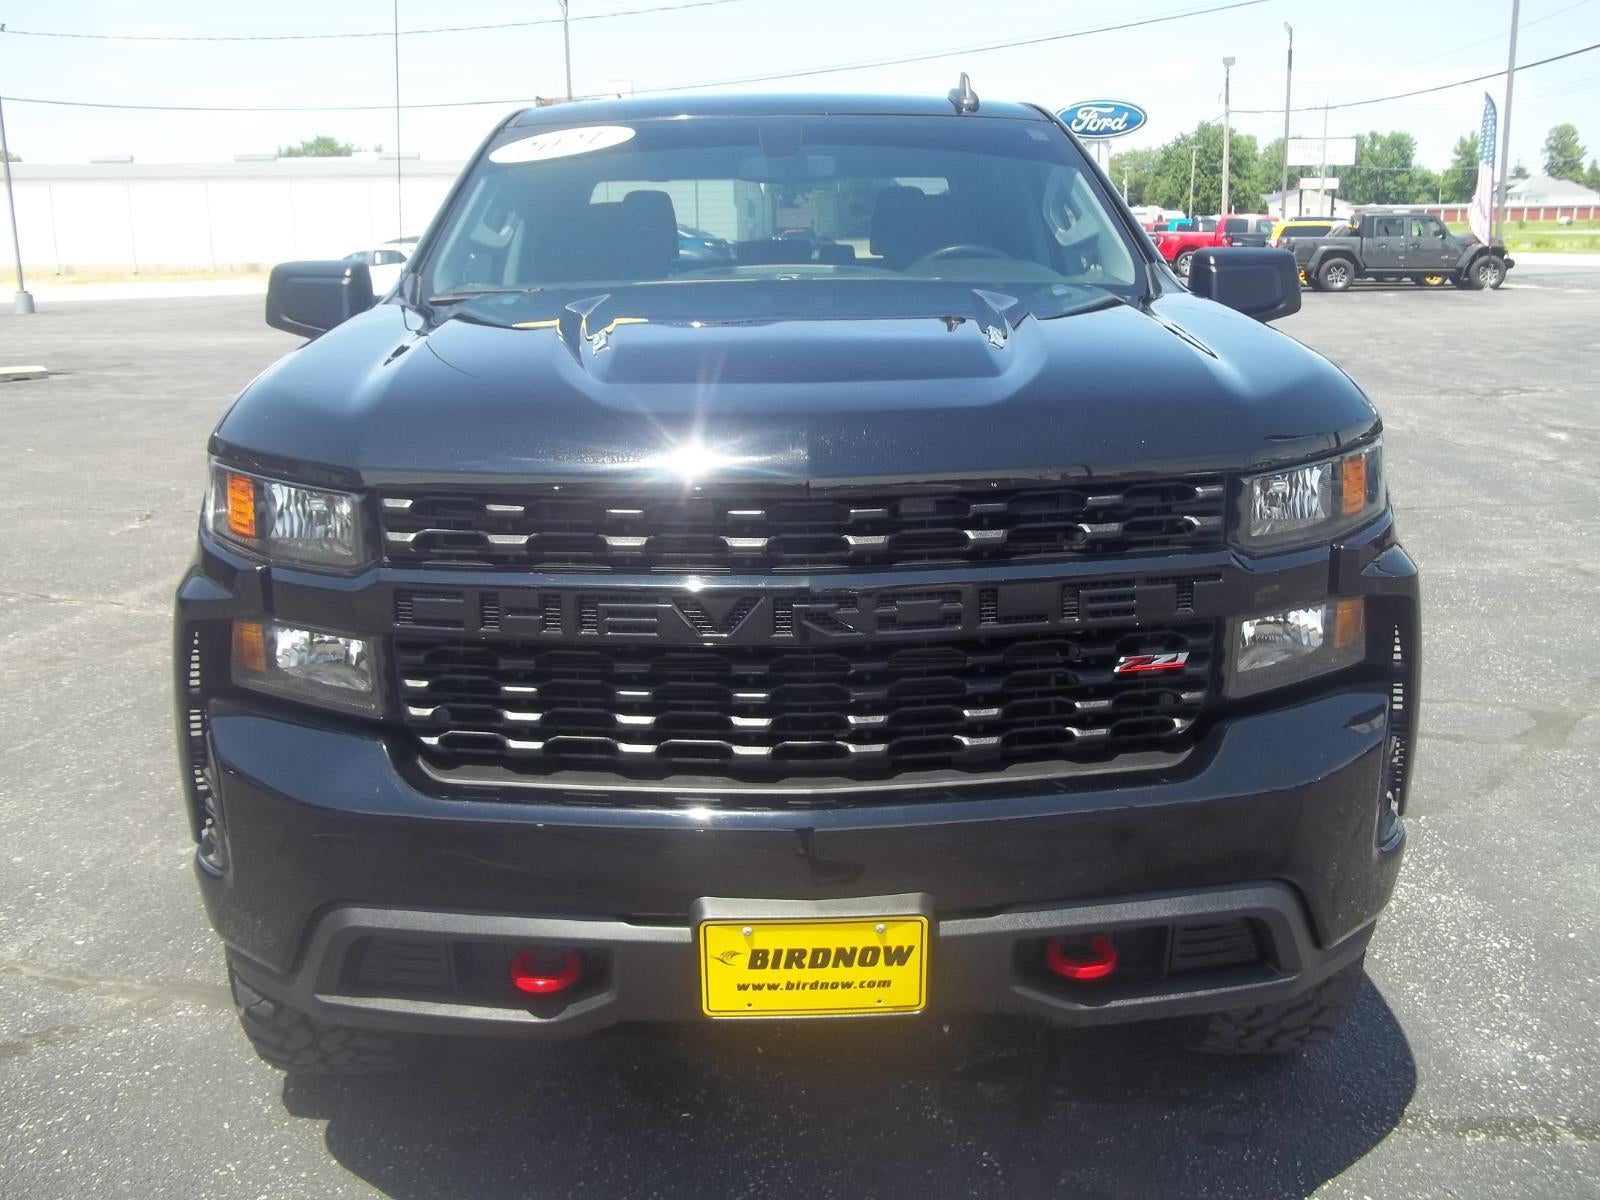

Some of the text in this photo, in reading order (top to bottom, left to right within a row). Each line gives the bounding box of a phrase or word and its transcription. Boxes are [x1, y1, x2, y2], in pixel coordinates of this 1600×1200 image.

[1070, 106, 1129, 132] Ford
[393, 571, 1224, 639] CHEVROLET
[747, 945, 916, 970] BIRDNOW
[735, 979, 892, 992] www.birdnow.com
